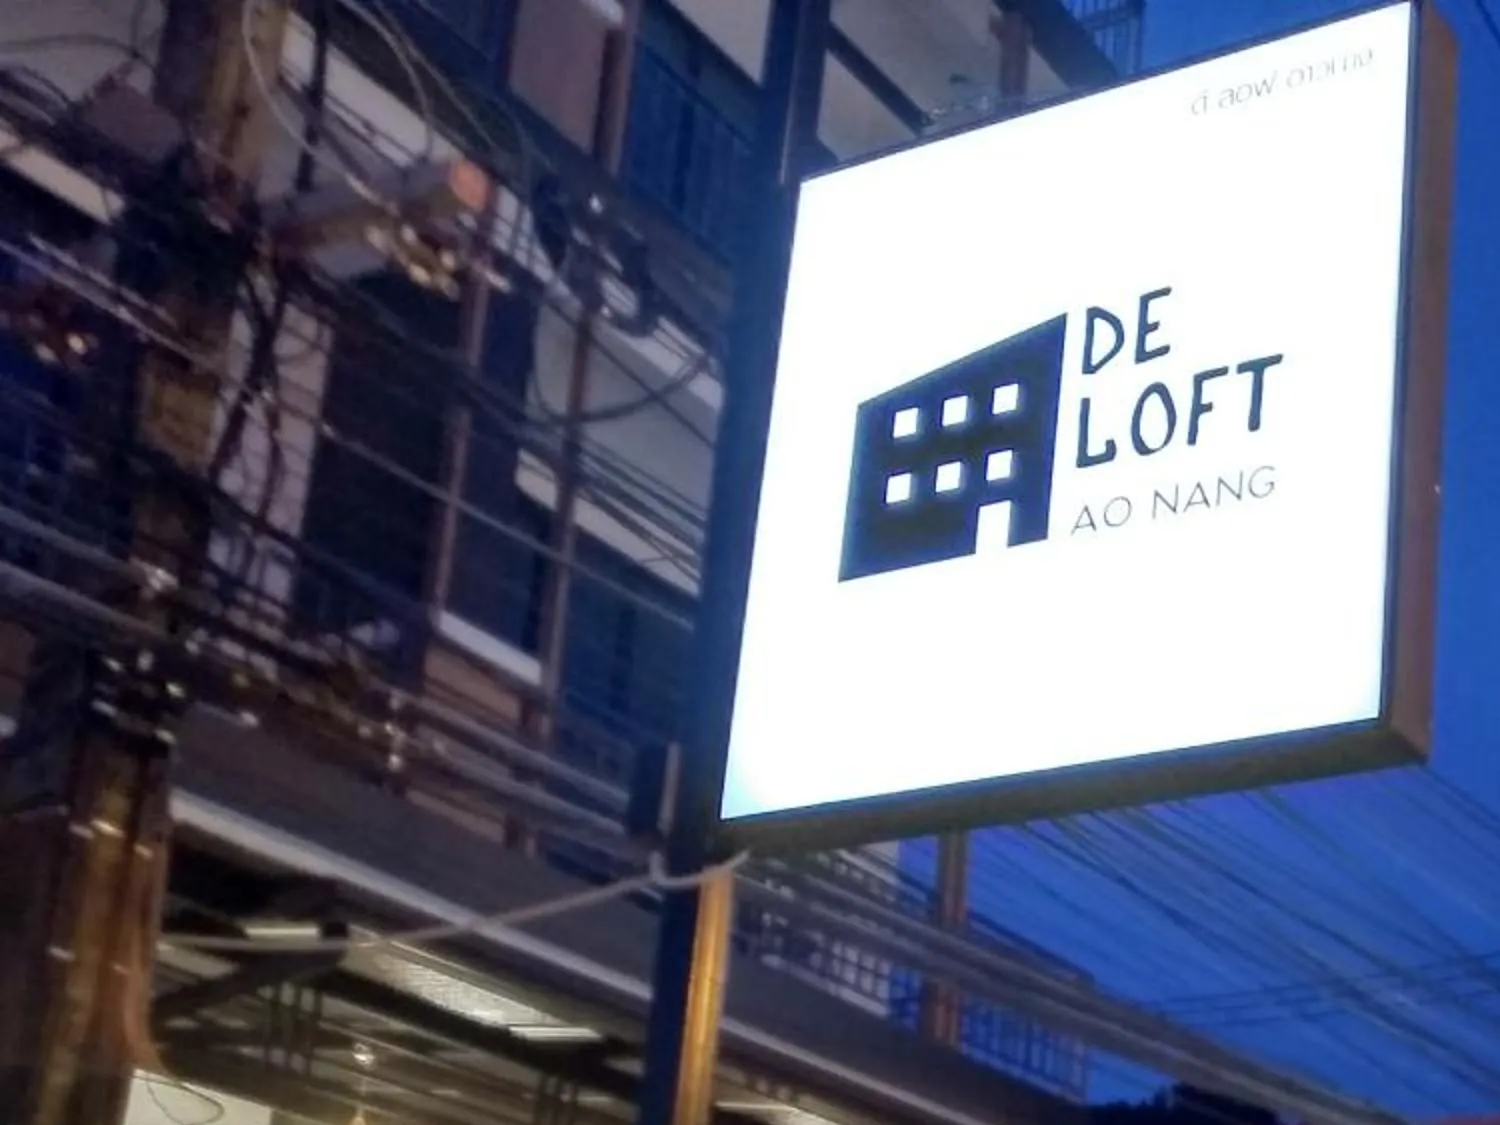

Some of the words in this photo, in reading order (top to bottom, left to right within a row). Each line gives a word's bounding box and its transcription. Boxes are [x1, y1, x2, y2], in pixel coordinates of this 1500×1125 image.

[1082, 286, 1172, 375] DE
[1076, 353, 1284, 468] LOFT
[1071, 496, 1132, 536] AO
[1152, 465, 1277, 520] NANG
